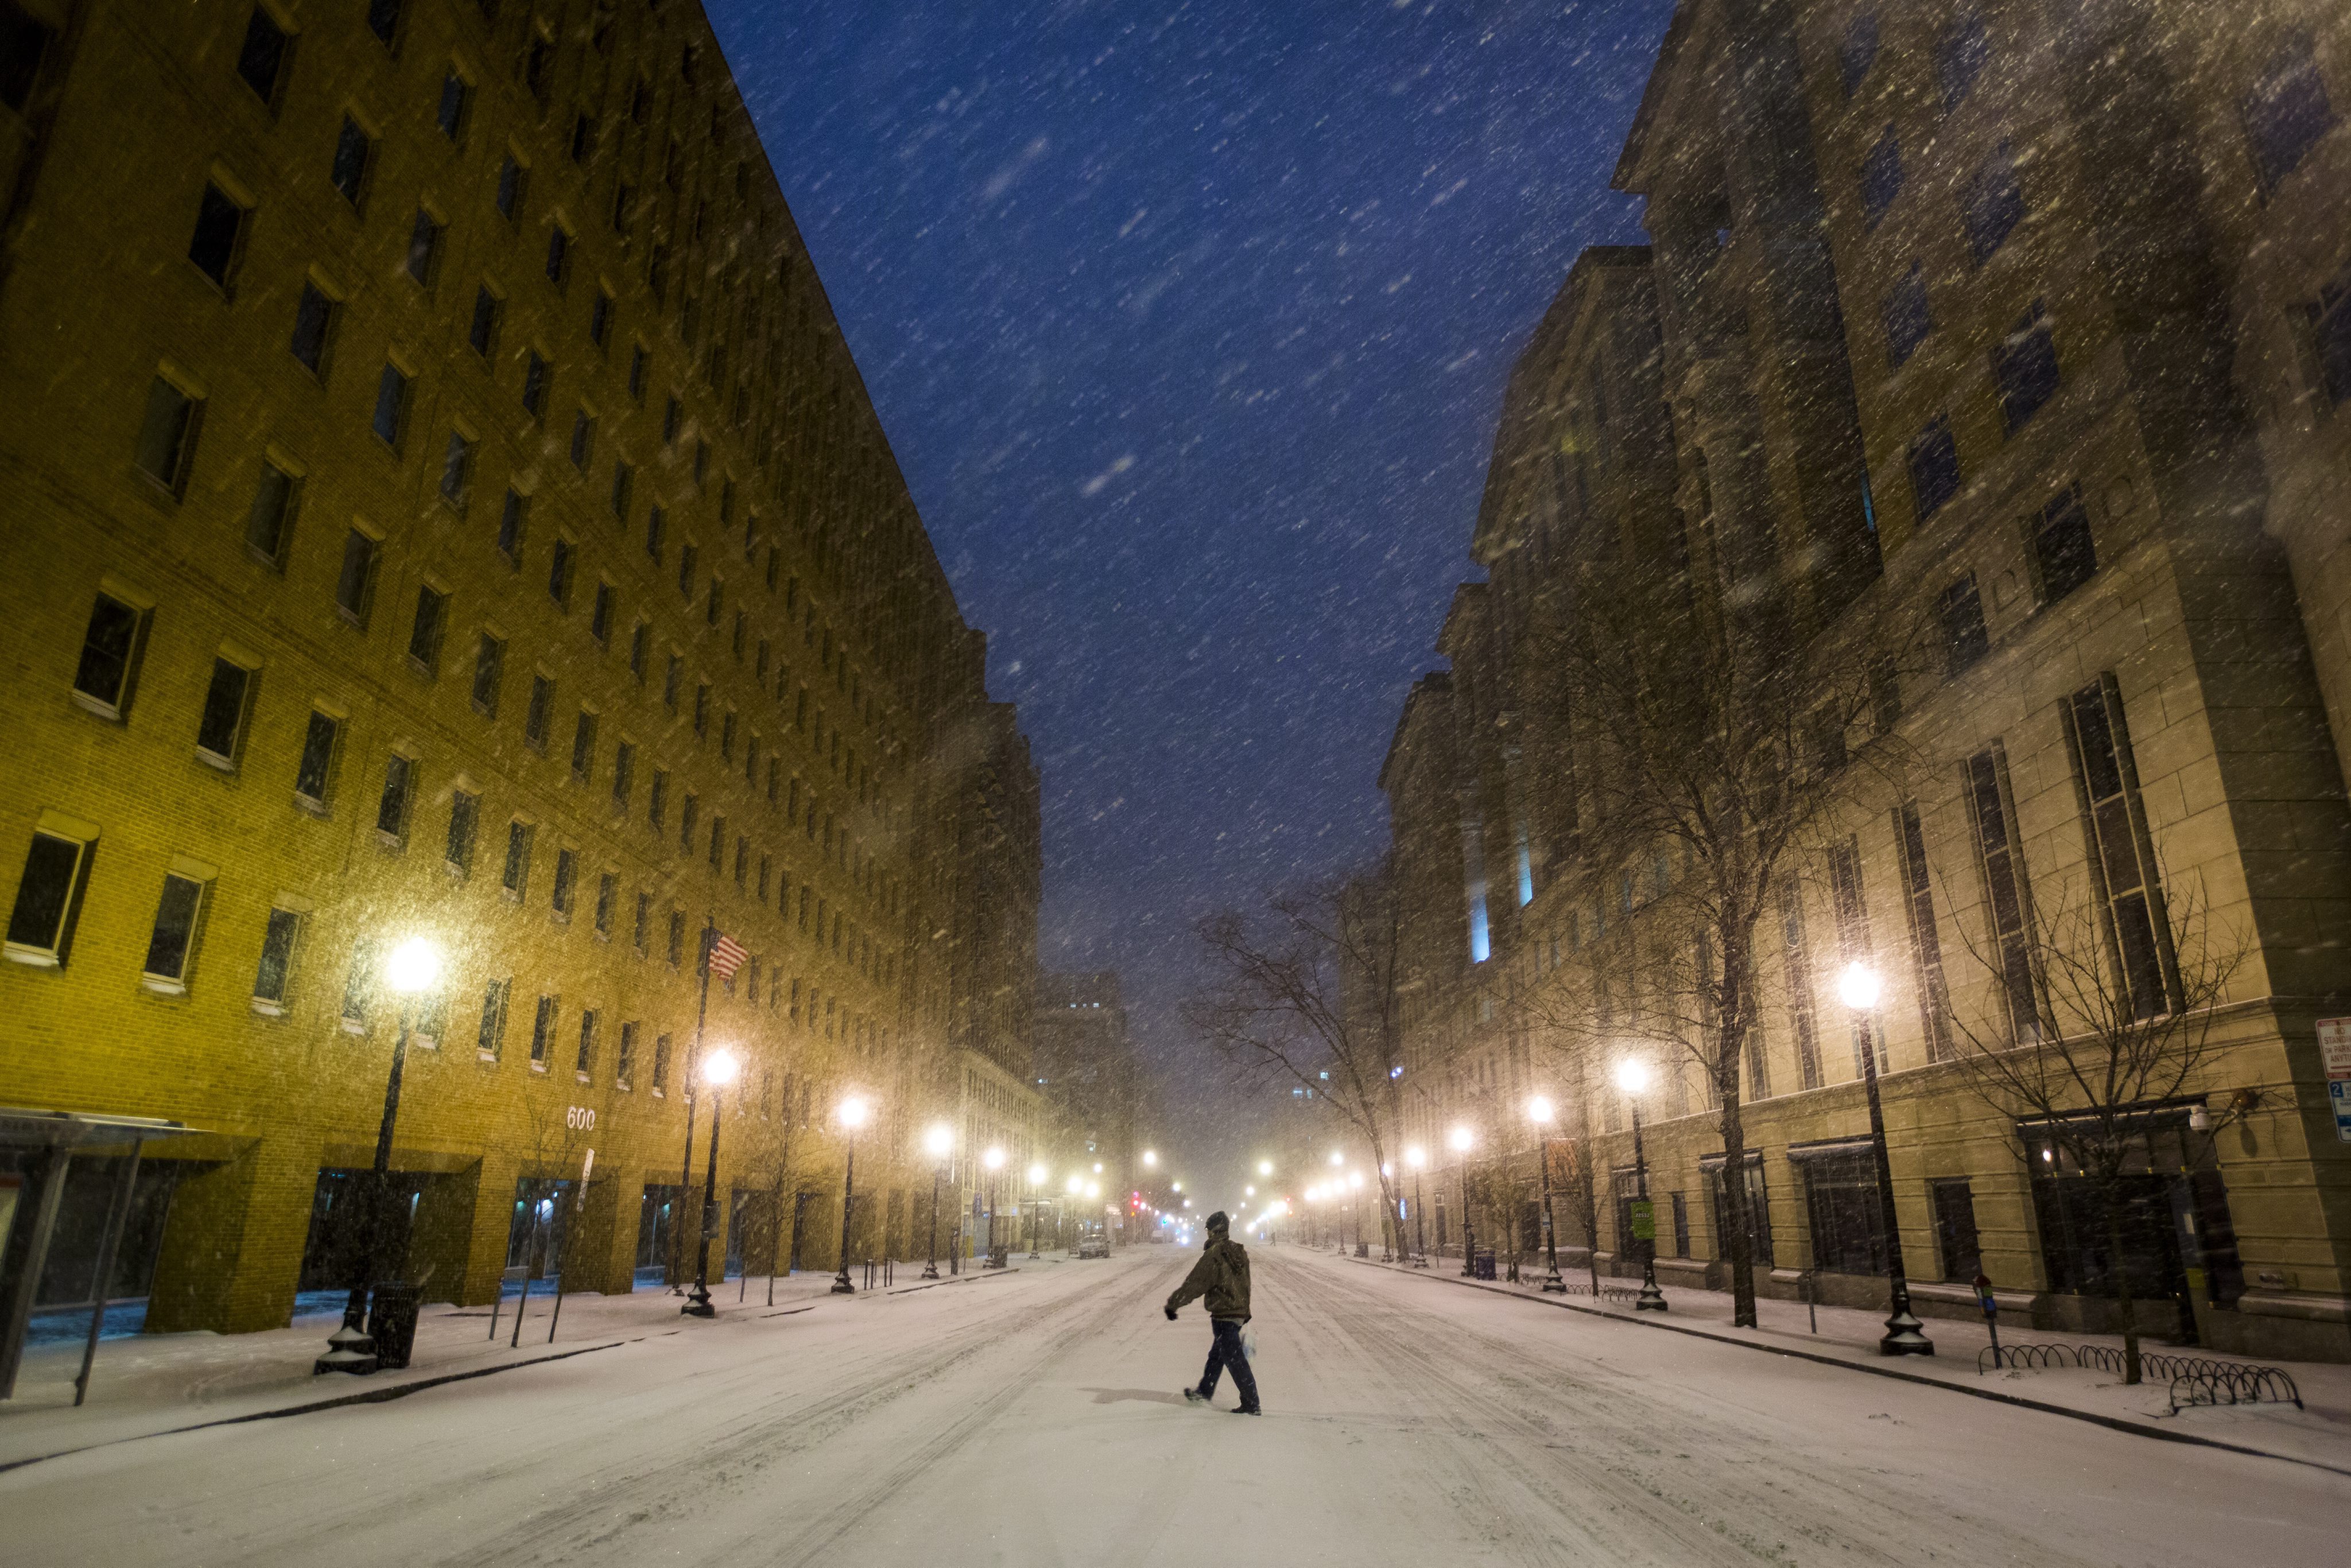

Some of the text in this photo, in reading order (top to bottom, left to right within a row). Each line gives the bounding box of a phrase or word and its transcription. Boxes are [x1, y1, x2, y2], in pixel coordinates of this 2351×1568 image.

[2334, 1027, 2346, 1035] NO
[2332, 1084, 2341, 1095] 2
[568, 1106, 595, 1131] 600
